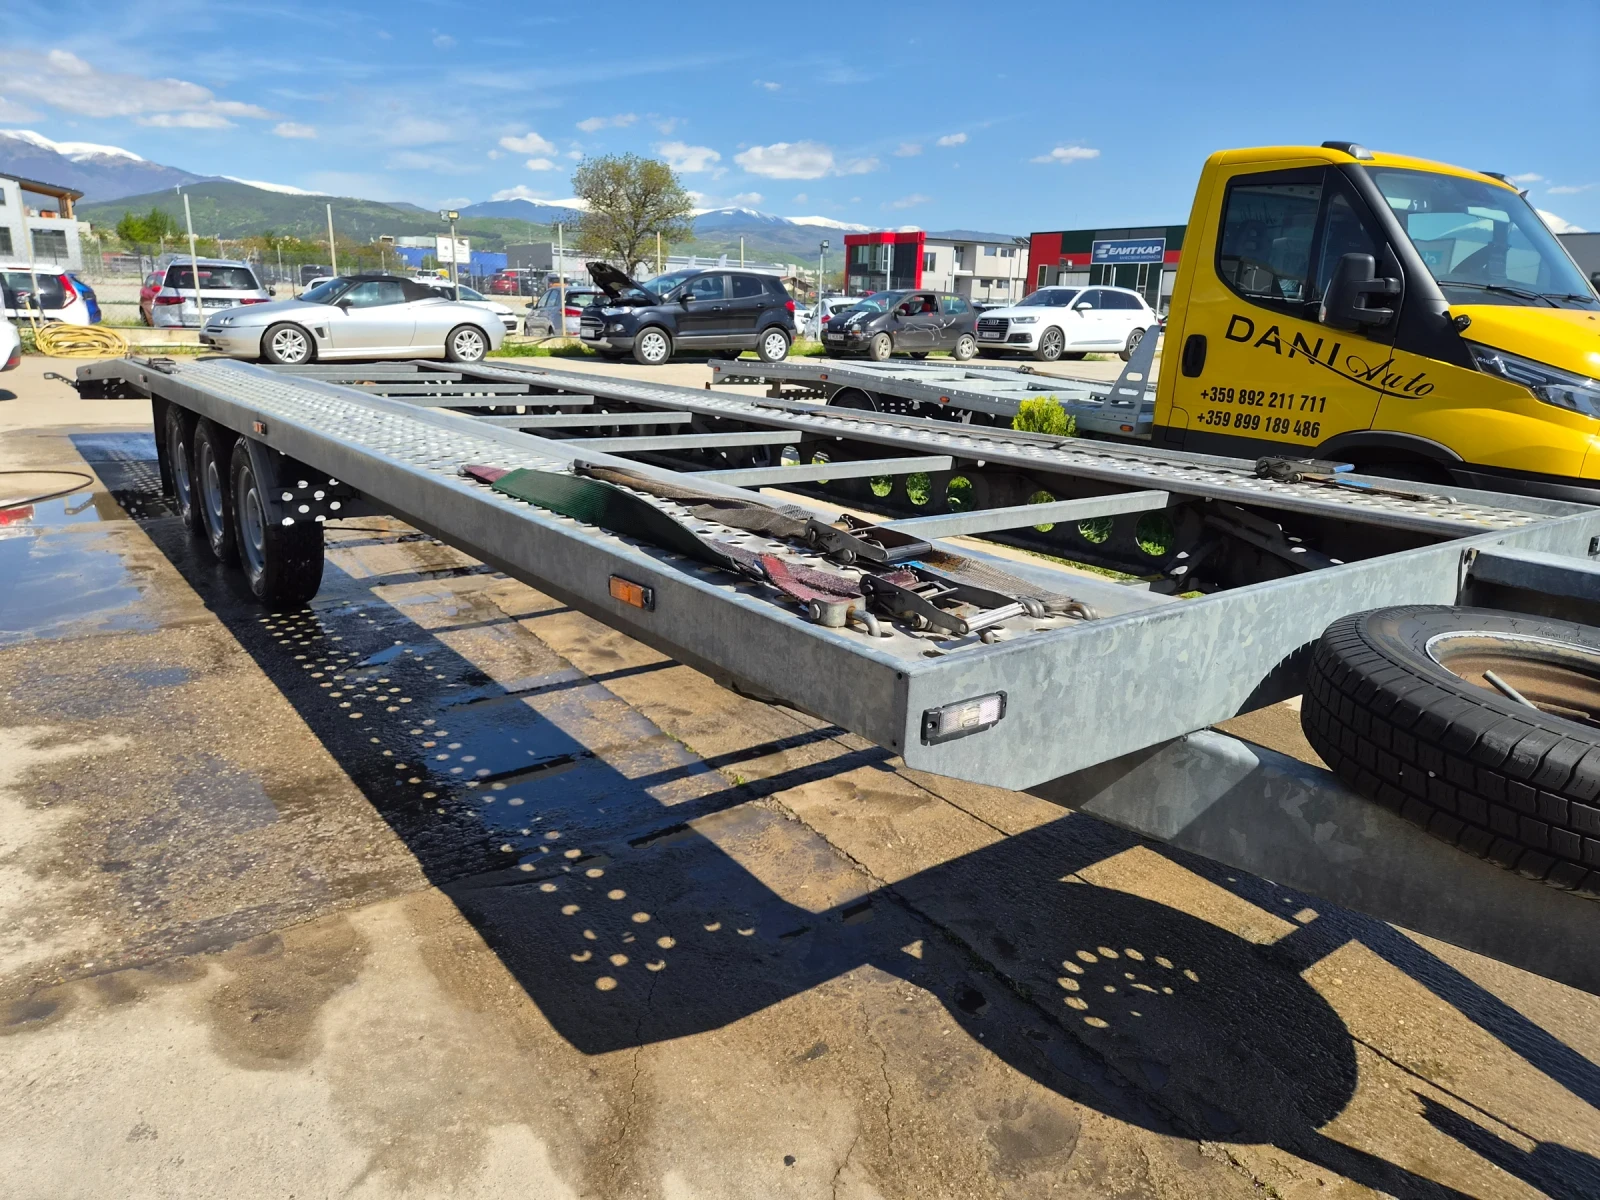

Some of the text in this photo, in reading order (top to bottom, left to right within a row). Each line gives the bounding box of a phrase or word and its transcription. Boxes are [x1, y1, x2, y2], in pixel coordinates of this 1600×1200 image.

[1225, 314, 1435, 397] DANI Auto
[1200, 386, 1327, 413] +359 892 211 711
[1197, 409, 1321, 439] +359 899 189 486
